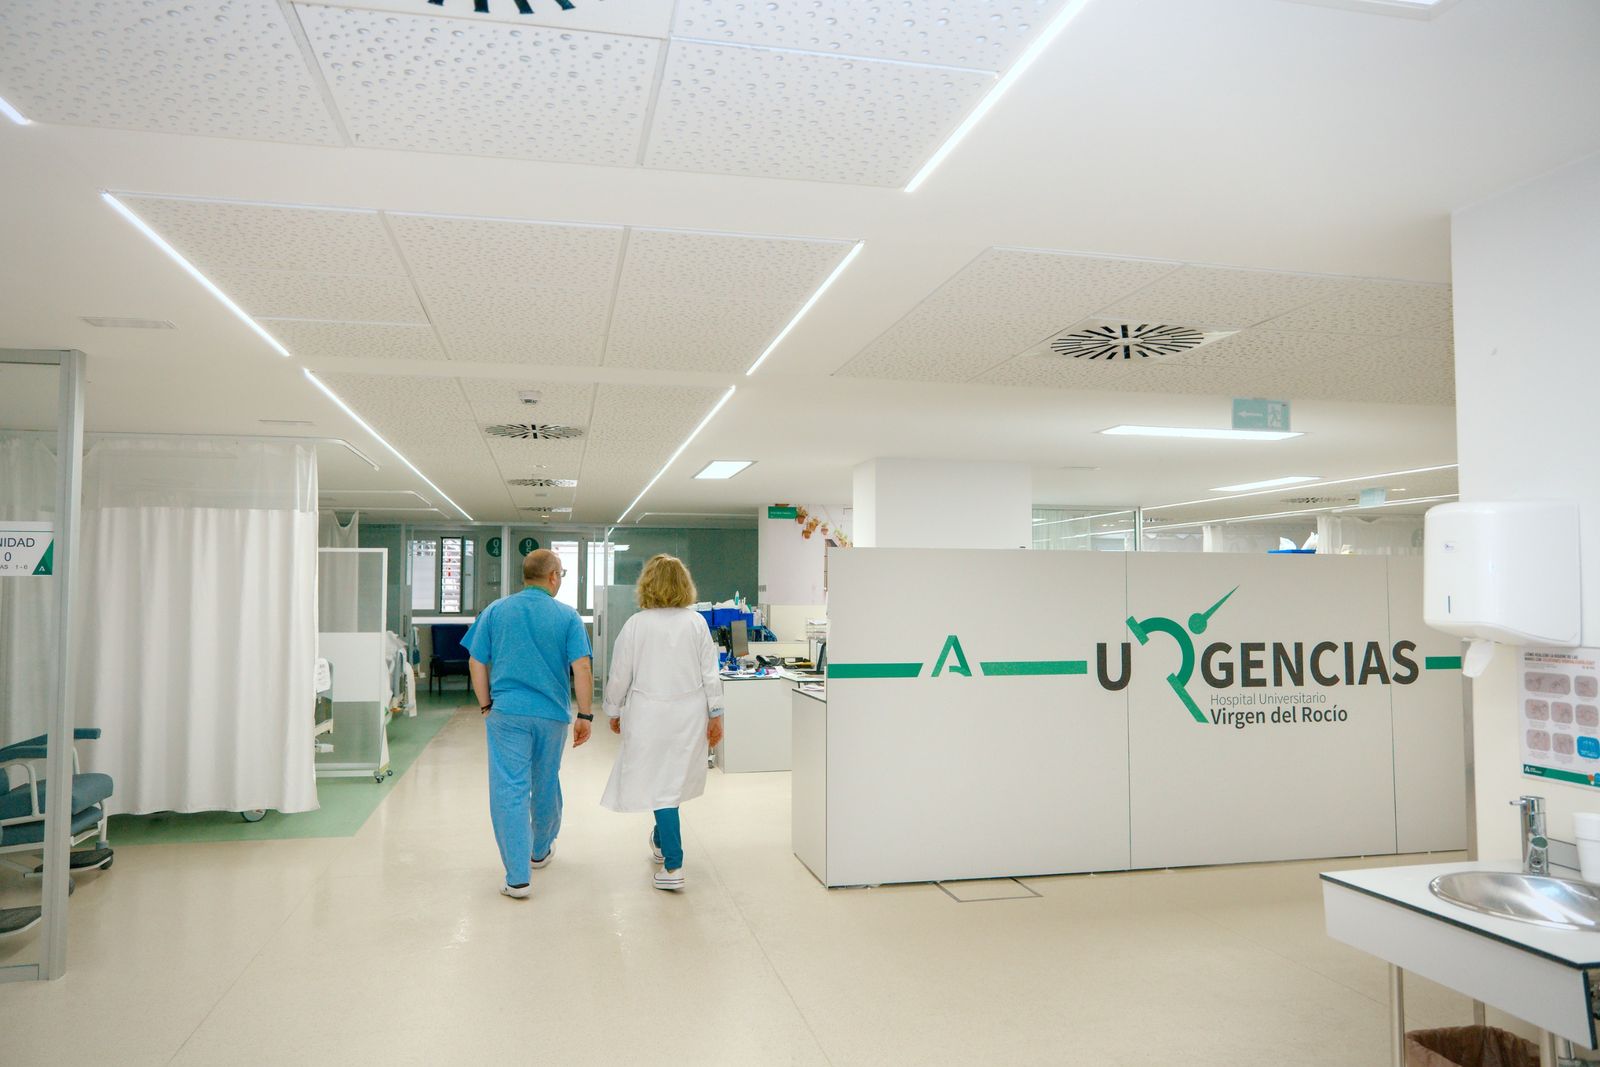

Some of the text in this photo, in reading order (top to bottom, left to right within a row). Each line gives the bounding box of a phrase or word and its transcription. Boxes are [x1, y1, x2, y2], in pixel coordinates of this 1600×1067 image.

[1096, 614, 1420, 723] URGENCIAS
[1210, 692, 1327, 708] Hospital Universitario
[1210, 704, 1348, 730] Virgen del Rocío
